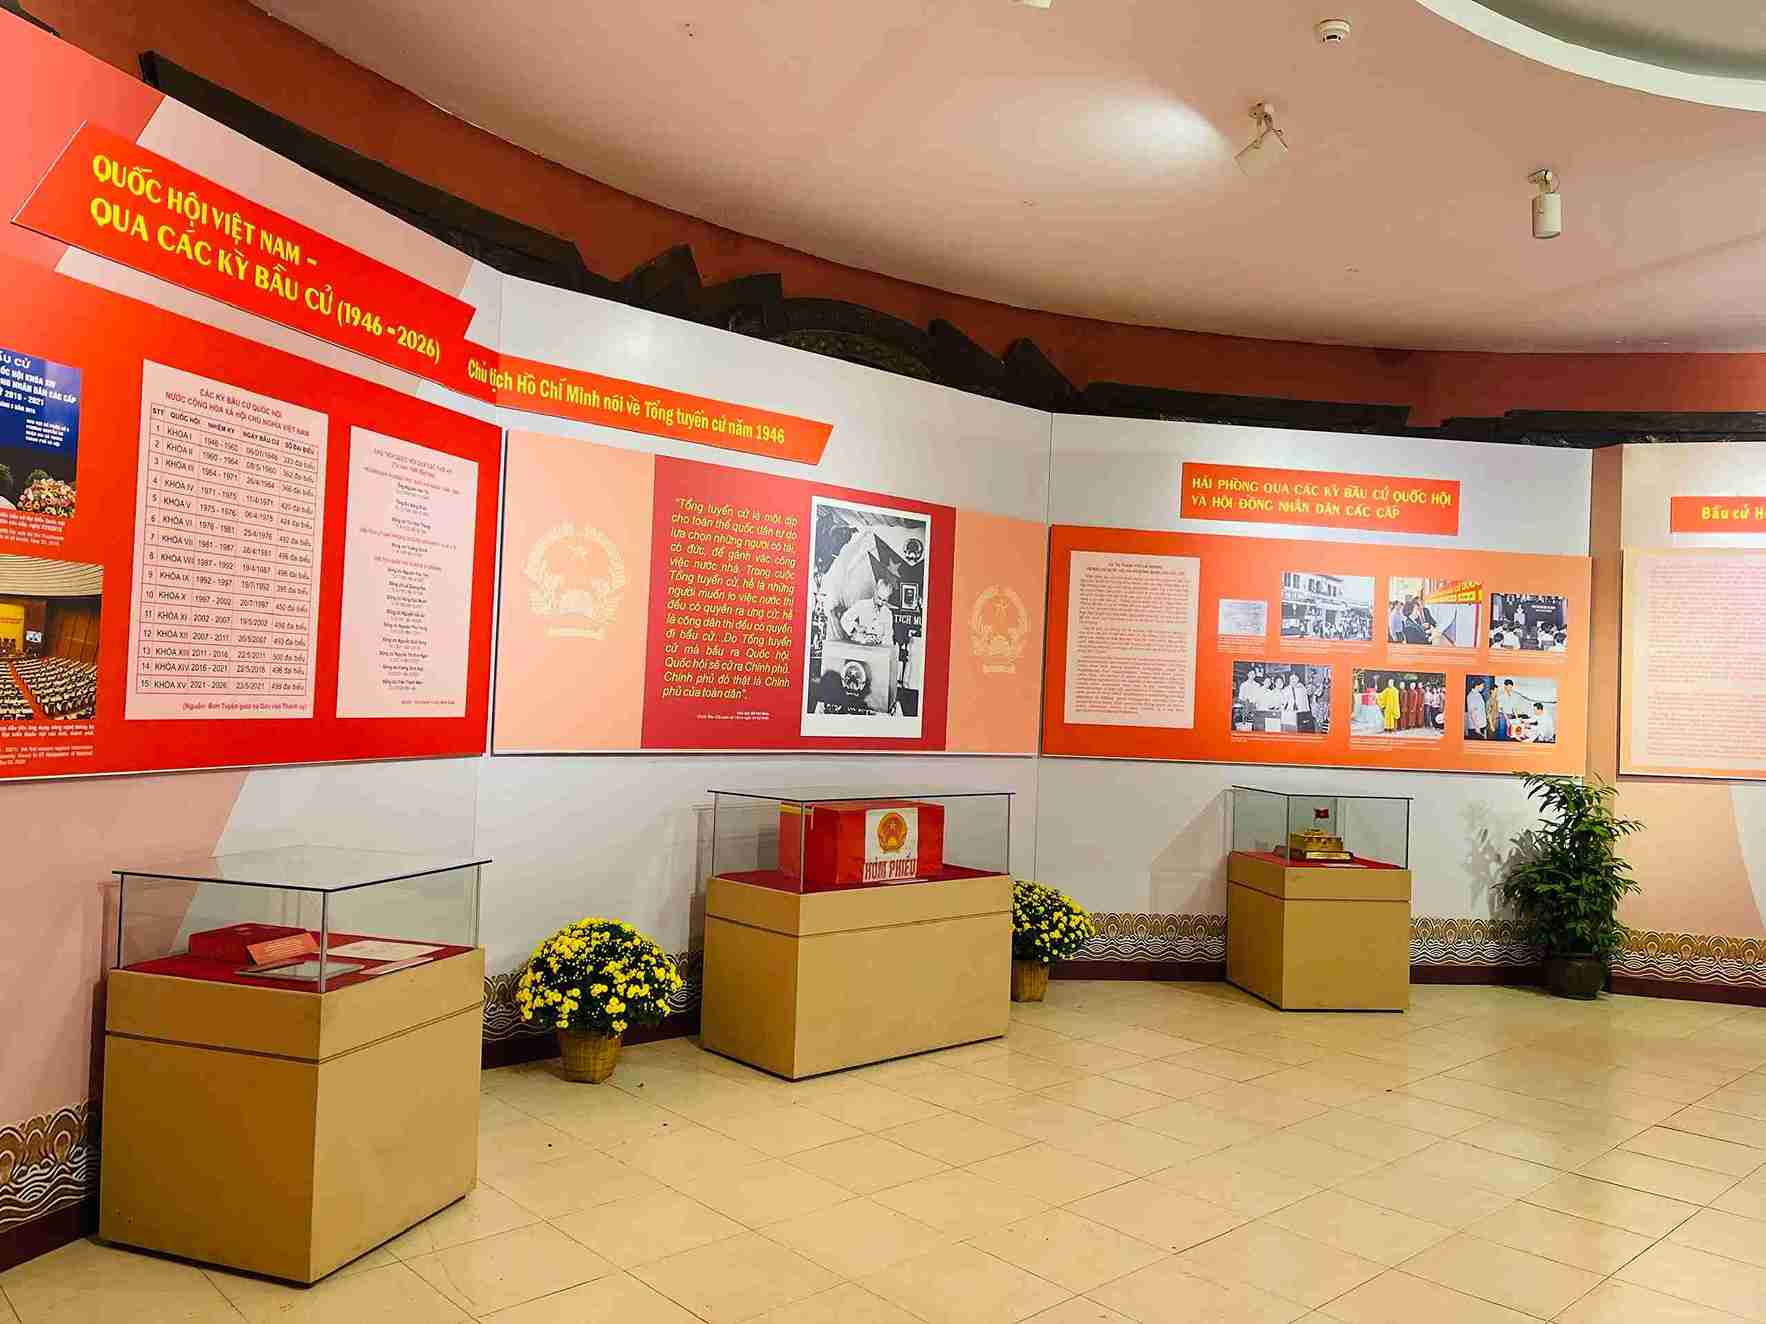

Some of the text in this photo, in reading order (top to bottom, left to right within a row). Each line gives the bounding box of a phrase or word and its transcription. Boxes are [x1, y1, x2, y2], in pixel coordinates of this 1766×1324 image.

[92, 154, 161, 204] QUỐC
[167, 186, 207, 226] HỘI
[213, 207, 254, 244] VIỆT
[260, 229, 301, 265] NAM
[90, 198, 149, 242] QUA
[157, 224, 212, 266] CÁC
[217, 248, 249, 281] KỲ
[255, 262, 298, 302] BẦU
[305, 284, 333, 316] CỬ
[337, 300, 382, 336] (1946
[468, 359, 784, 444] Chủ tịch Hồ Chí Minh nói về Tổng tuyển cử năm 1946
[1192, 474, 1451, 509] HẢI PHÒNG QUA CÁC KỲ BẦU CỬ QUỐC HỘI
